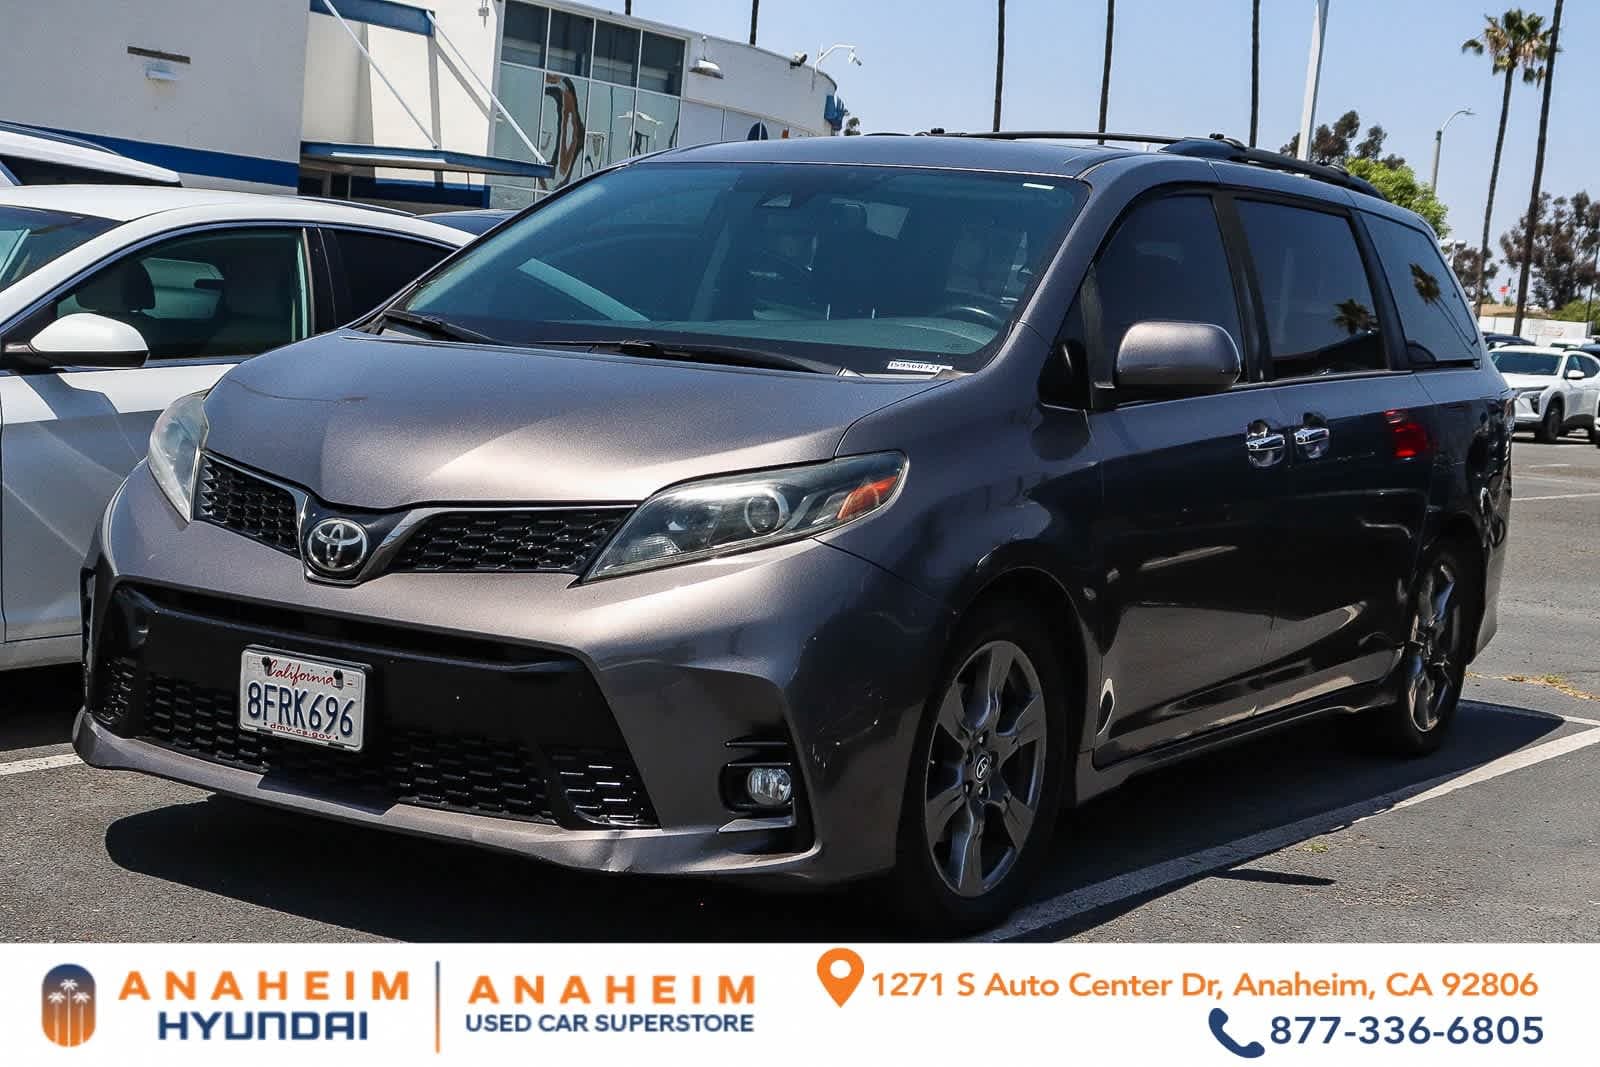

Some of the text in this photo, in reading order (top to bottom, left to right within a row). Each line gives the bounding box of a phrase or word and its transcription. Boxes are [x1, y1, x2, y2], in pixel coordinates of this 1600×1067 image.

[267, 659, 338, 689] California
[247, 681, 355, 737] 8FRK696
[269, 723, 332, 740] dmv.ca.gov
